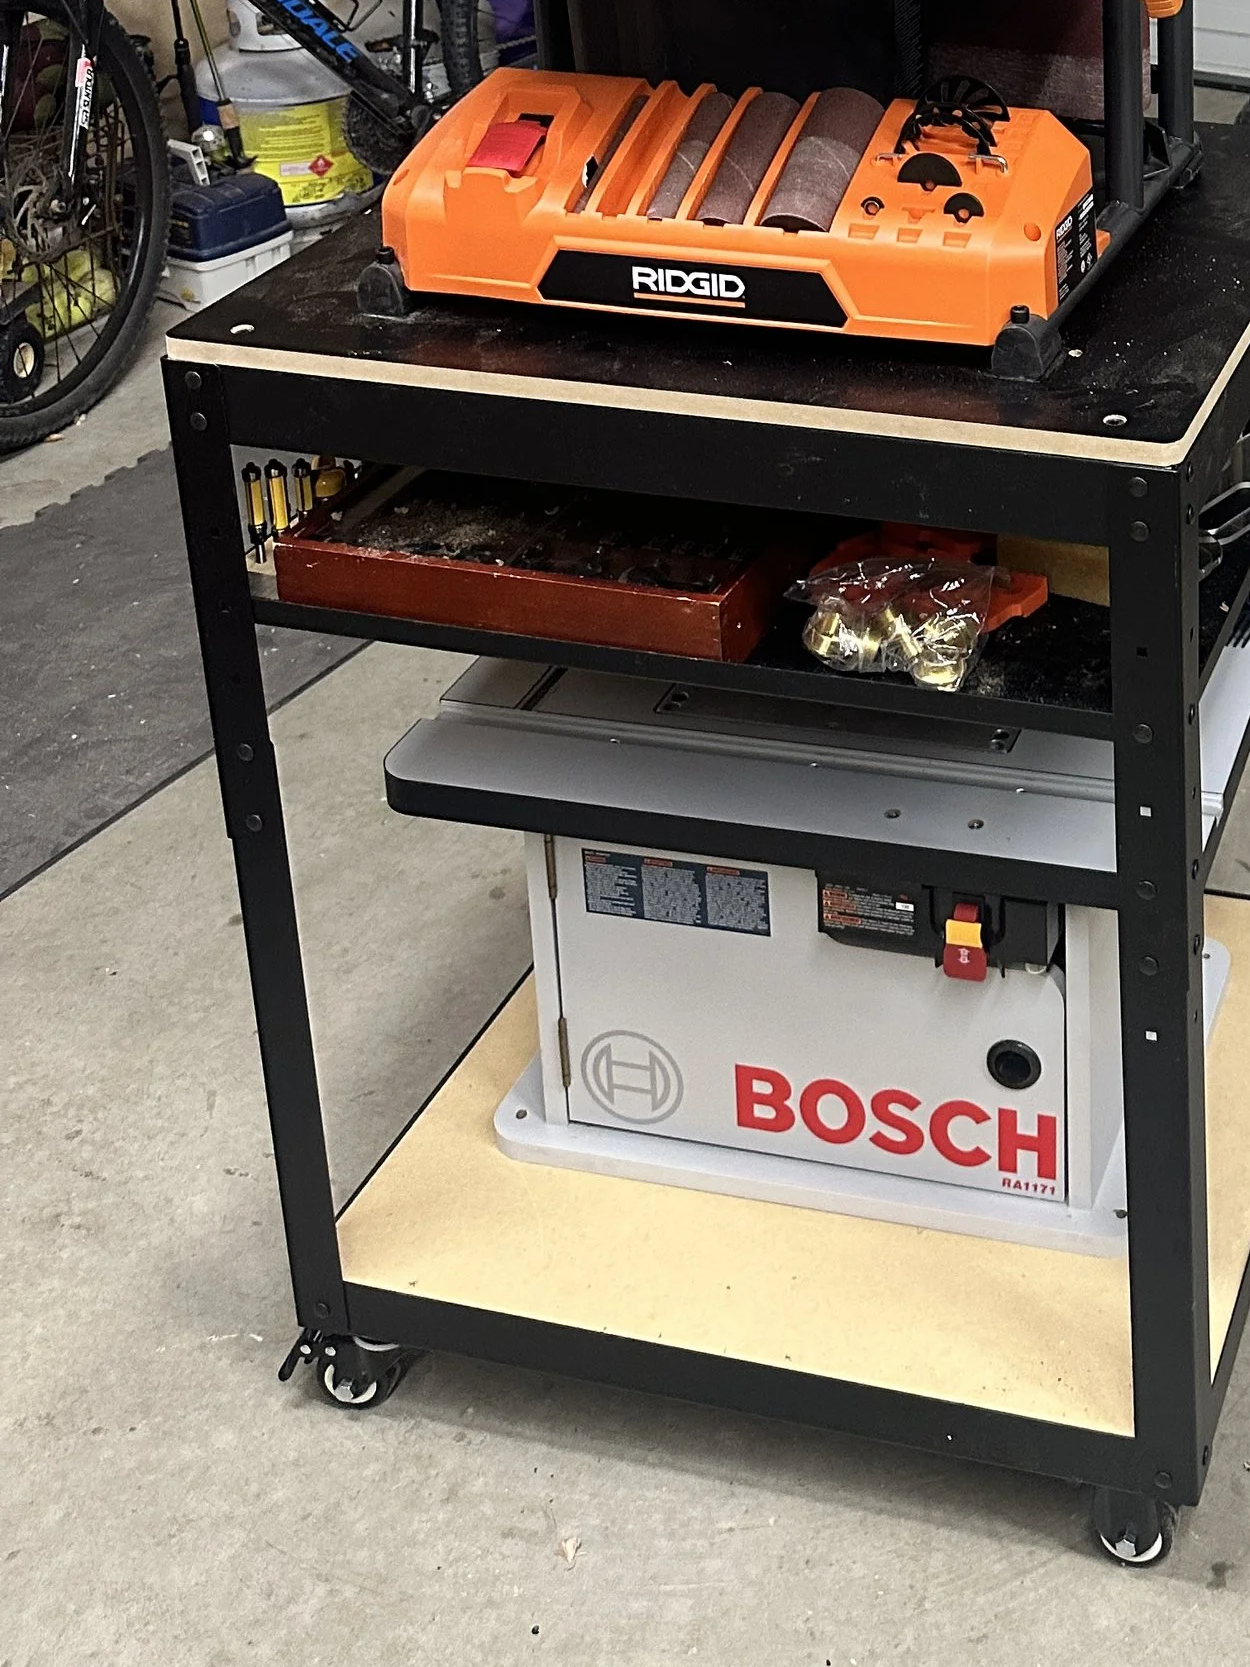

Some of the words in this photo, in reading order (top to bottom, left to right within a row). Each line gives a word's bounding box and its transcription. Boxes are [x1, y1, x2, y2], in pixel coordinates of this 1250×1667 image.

[632, 266, 745, 299] RIDGID
[735, 1064, 1057, 1180] BOSCH
[1002, 1177, 1056, 1196] RA1171
